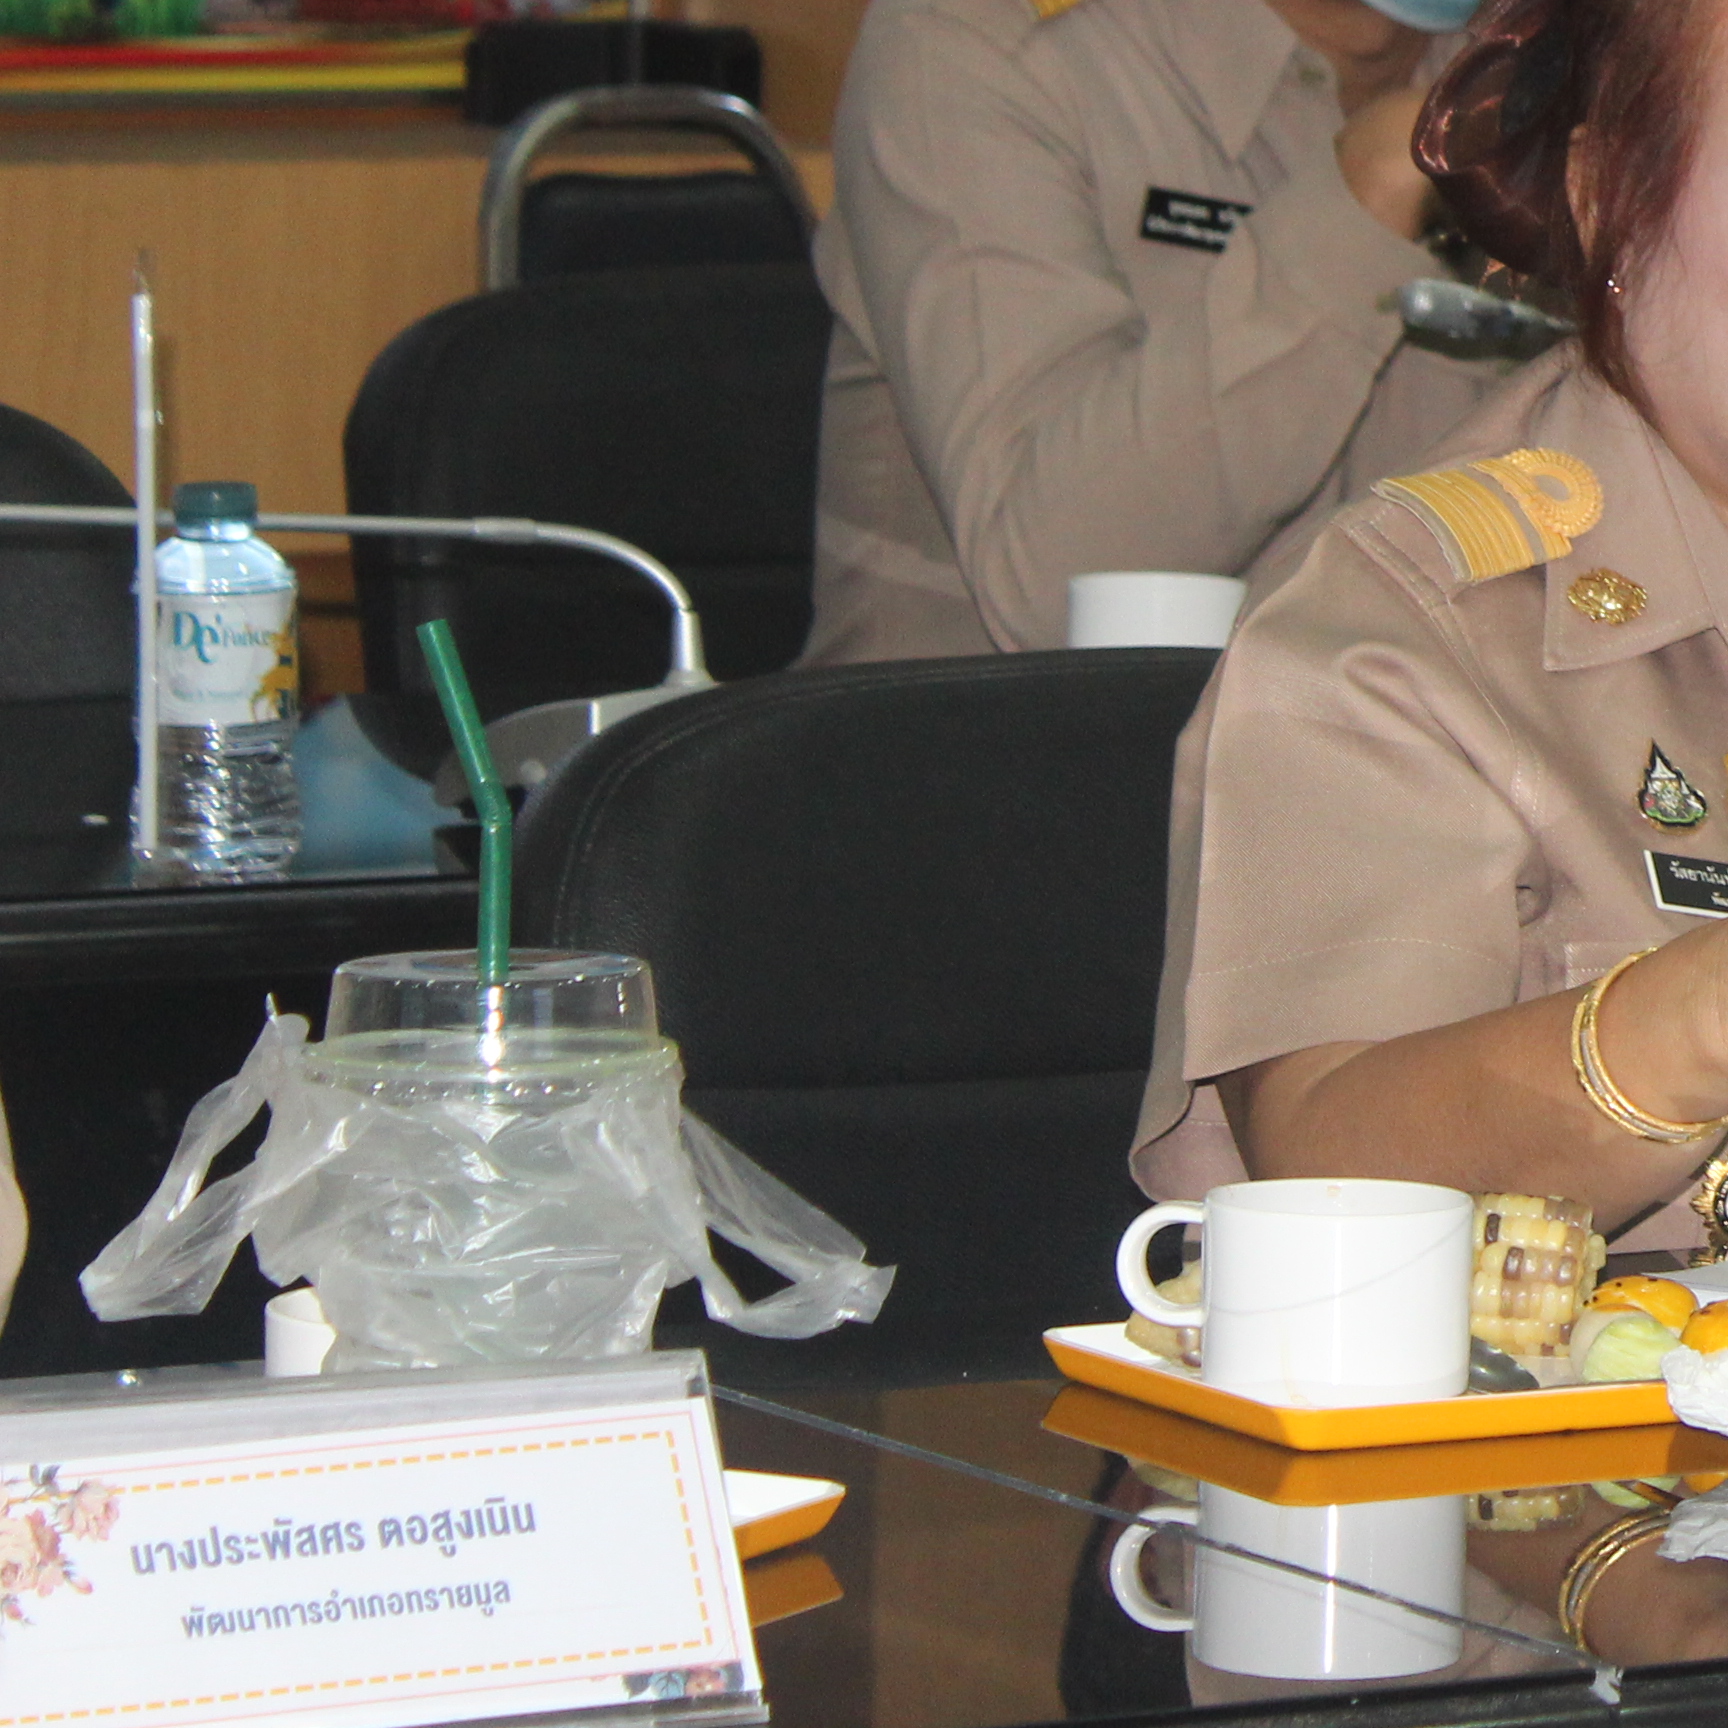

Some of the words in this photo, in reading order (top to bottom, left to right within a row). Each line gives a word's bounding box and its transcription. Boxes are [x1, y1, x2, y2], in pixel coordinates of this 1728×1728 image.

[129, 1516, 367, 1575] นางประพัสศร
[376, 1495, 538, 1558] ตอสูงเนิน
[179, 1578, 513, 1639] พัฒนาการอำเภอทรายมูล
